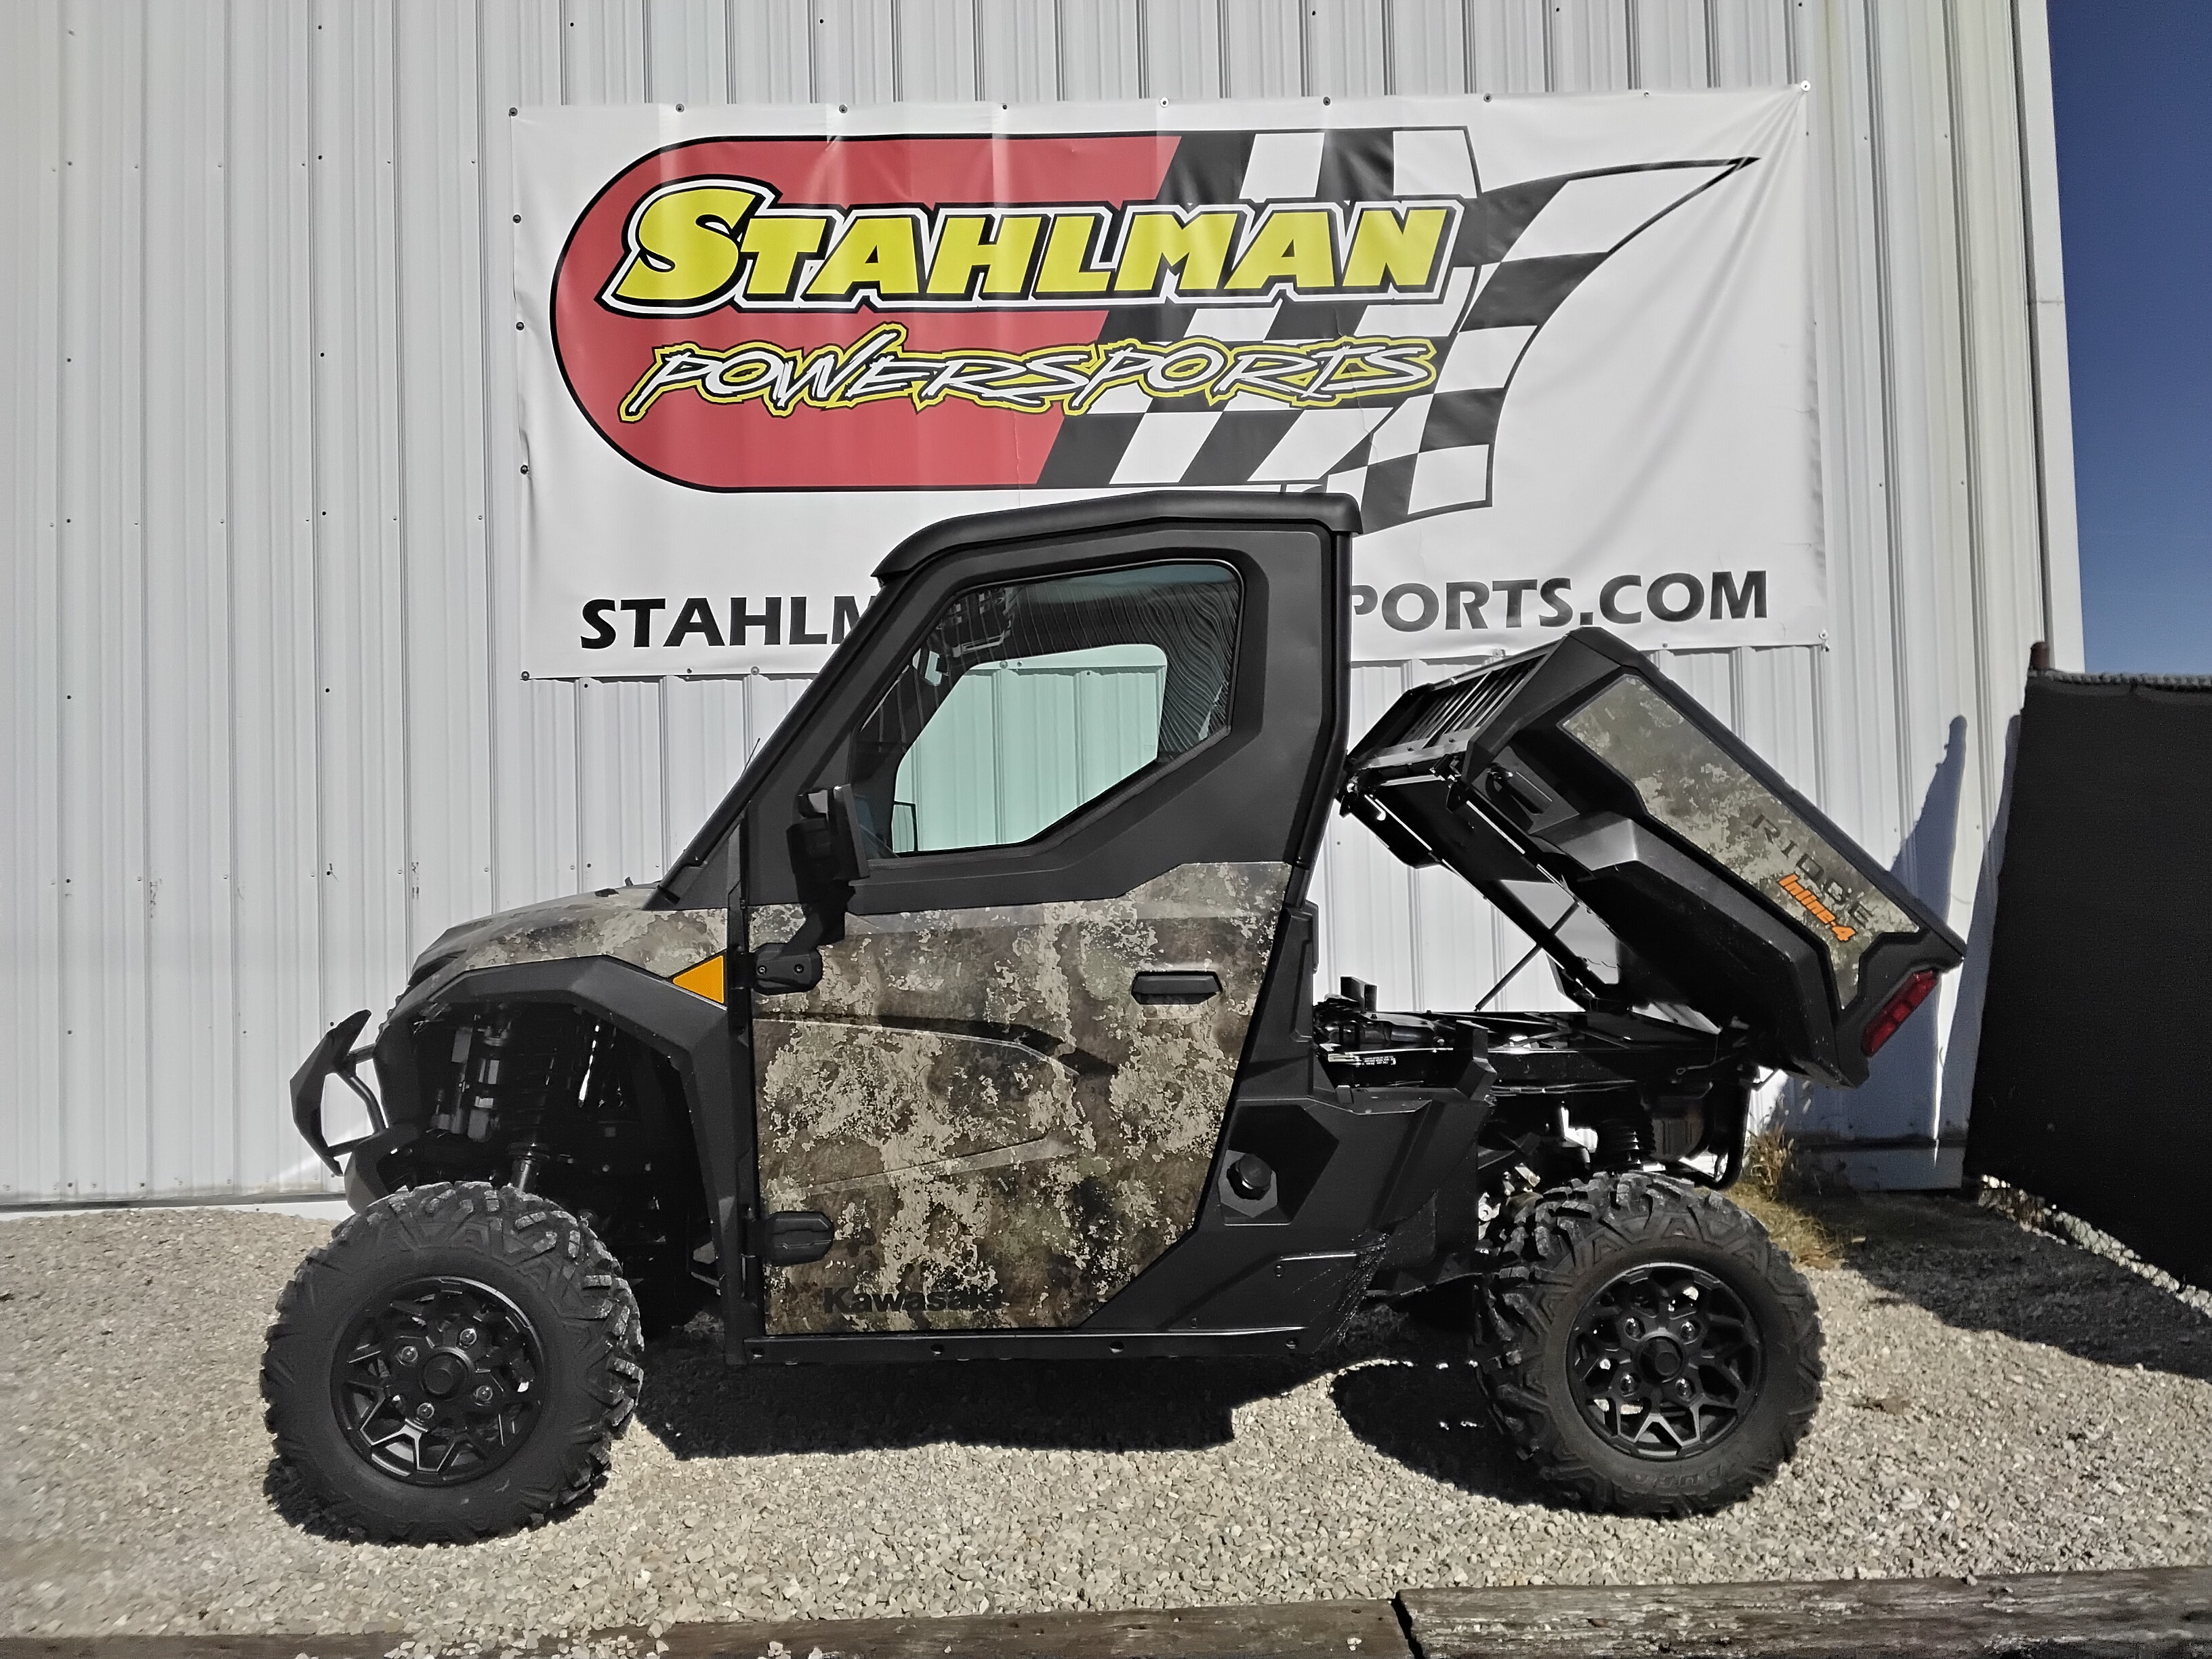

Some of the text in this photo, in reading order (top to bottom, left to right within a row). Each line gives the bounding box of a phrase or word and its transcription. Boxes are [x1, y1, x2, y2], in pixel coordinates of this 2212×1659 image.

[600, 179, 1457, 310] STAHLMAN
[621, 324, 1437, 420] POWERSPORTS
[1751, 814, 1874, 929] RIDGE
[823, 1286, 1003, 1313] Kawasaki
